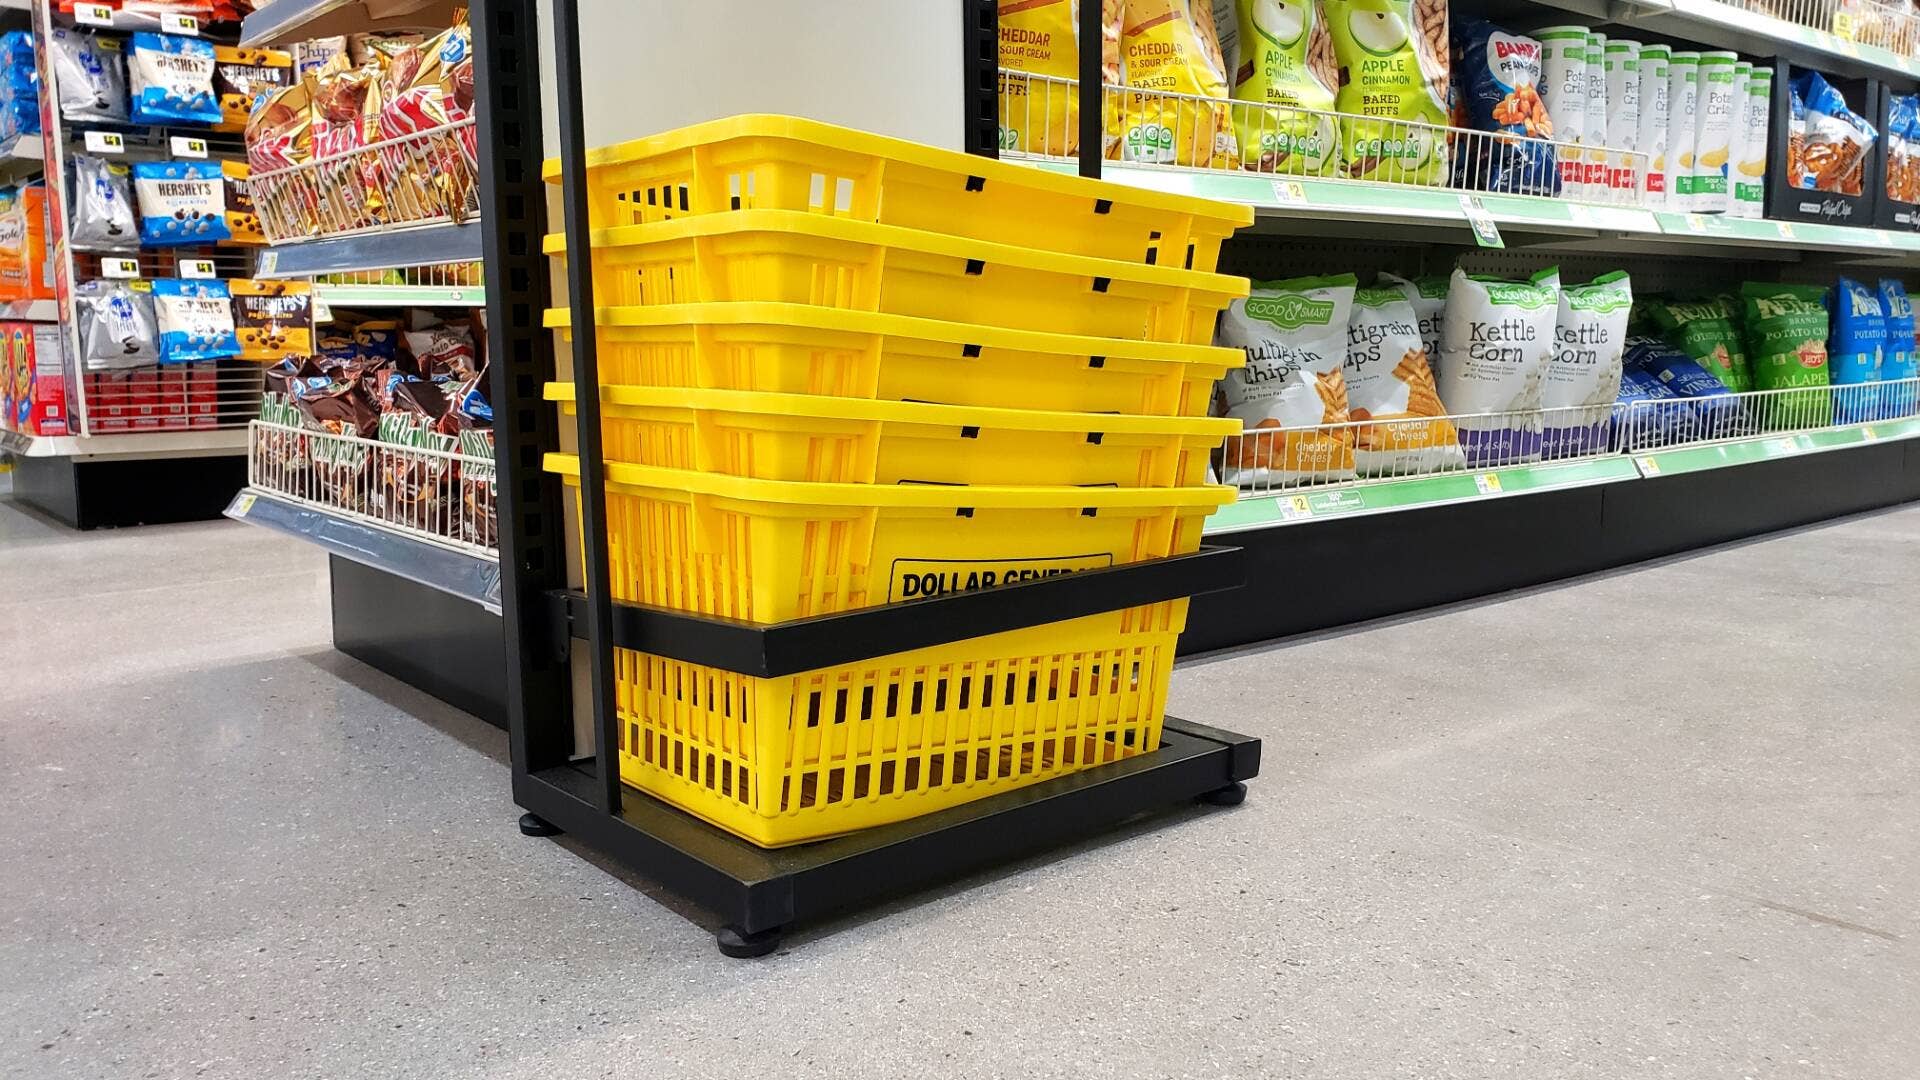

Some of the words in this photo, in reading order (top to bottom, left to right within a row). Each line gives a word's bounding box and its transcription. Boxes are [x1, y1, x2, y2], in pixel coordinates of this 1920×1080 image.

[999, 28, 1050, 47] HEDDAR
[1000, 46, 1025, 56] SOUR
[1027, 48, 1051, 60] CREAM
[1129, 43, 1183, 57] CHEDDAR
[1140, 58, 1161, 68] SOUR
[1265, 50, 1293, 70] APPLE
[1362, 59, 1404, 72] APPLE
[1132, 77, 1176, 88] BAKED
[1362, 75, 1410, 85] CINNAMON
[1266, 88, 1299, 99] BAKED
[1363, 95, 1400, 104] BAKED
[1363, 106, 1399, 115] PUFFS
[158, 183, 212, 197] HERSHEY'S
[1248, 302, 1285, 316] GOOD
[1285, 301, 1302, 320] &
[1300, 307, 1331, 319] SMART
[1469, 318, 1535, 342] Kettle
[1555, 323, 1608, 345] Kettle
[1766, 328, 1811, 341] POTATO
[1243, 338, 1322, 364] ultigin
[1345, 345, 1380, 371] ips
[1469, 342, 1524, 363] Corn
[1773, 373, 1828, 388] JALAPE
[1392, 431, 1428, 441] Cheese
[1294, 498, 1307, 511] $2
[903, 572, 996, 597] DOLLAR
